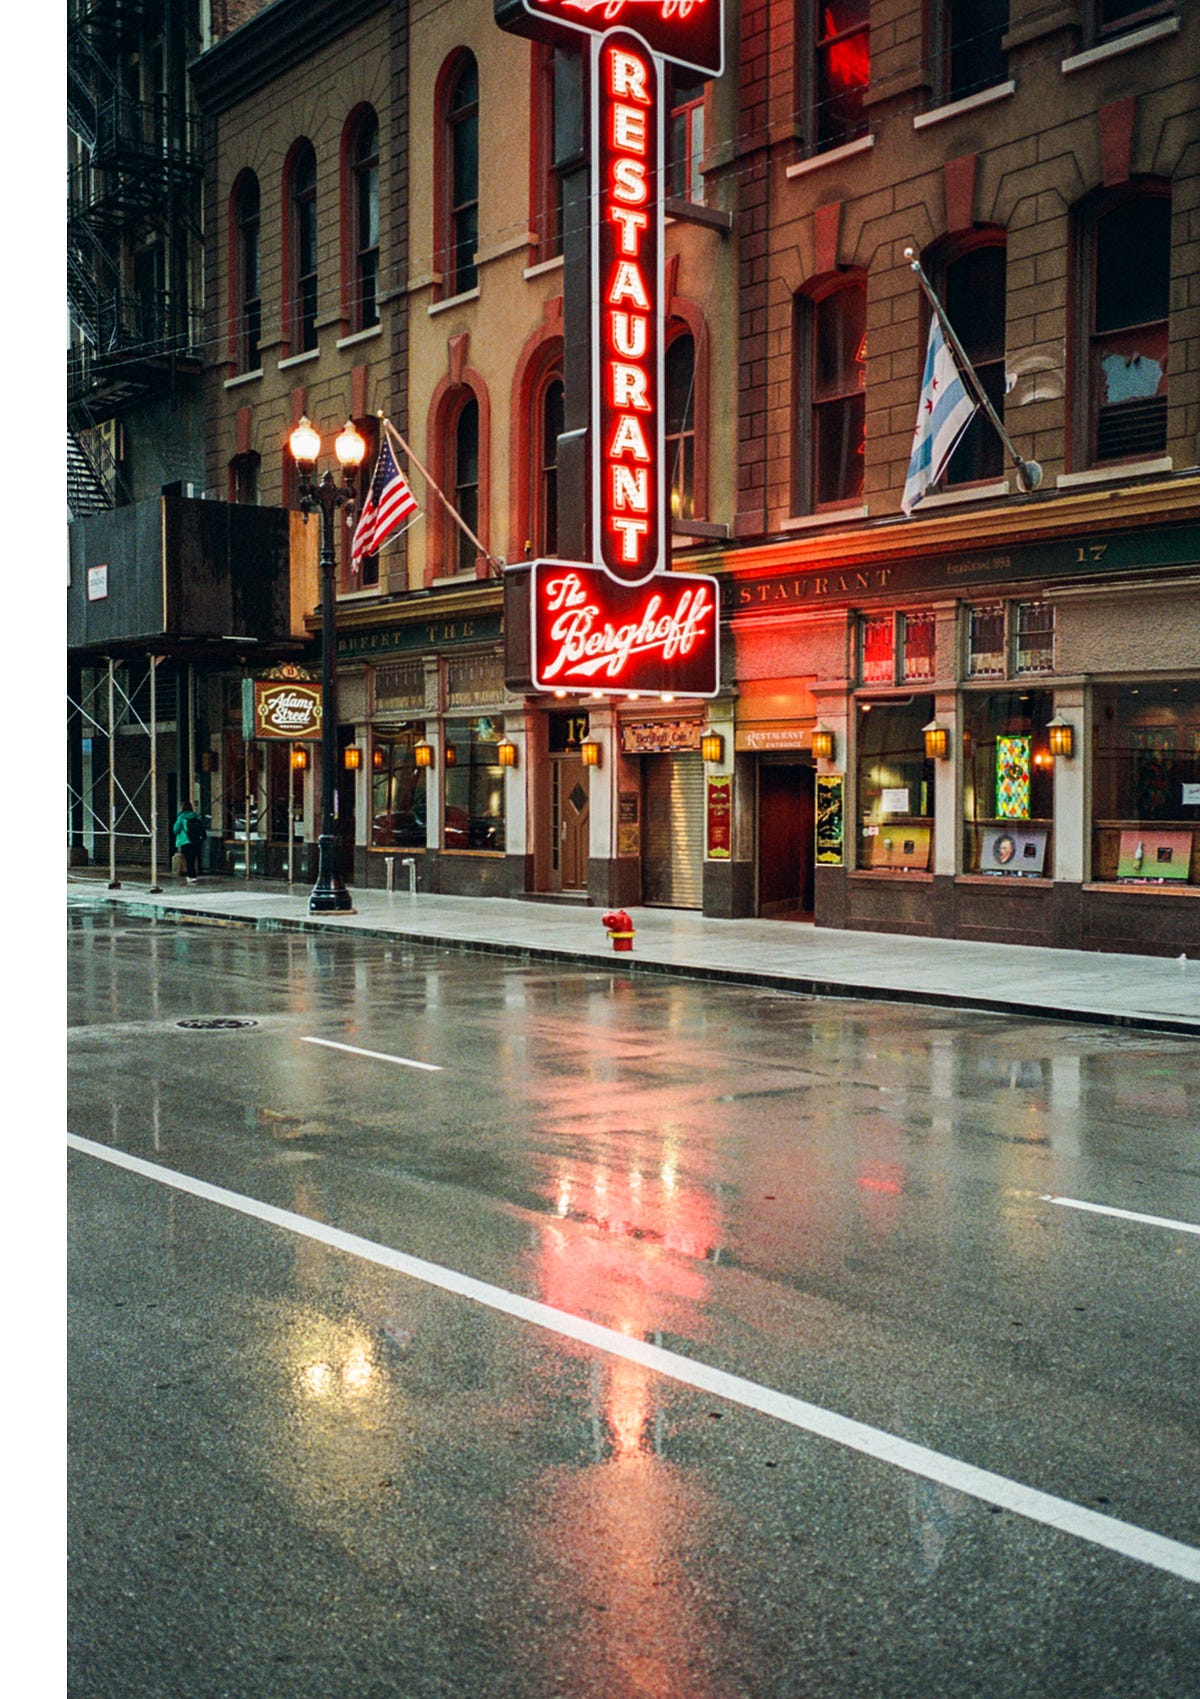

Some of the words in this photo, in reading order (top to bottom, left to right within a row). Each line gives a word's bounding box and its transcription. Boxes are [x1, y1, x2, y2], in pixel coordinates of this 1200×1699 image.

[609, 48, 651, 562] RESTAURANT
[1075, 544, 1108, 563] 17
[546, 573, 587, 611] The
[722, 569, 892, 605] ESTAURANT
[426, 621, 475, 643] THE
[542, 587, 713, 679] Berghoff
[268, 692, 314, 709] Adams
[271, 707, 311, 724] Street
[567, 718, 587, 742] 17
